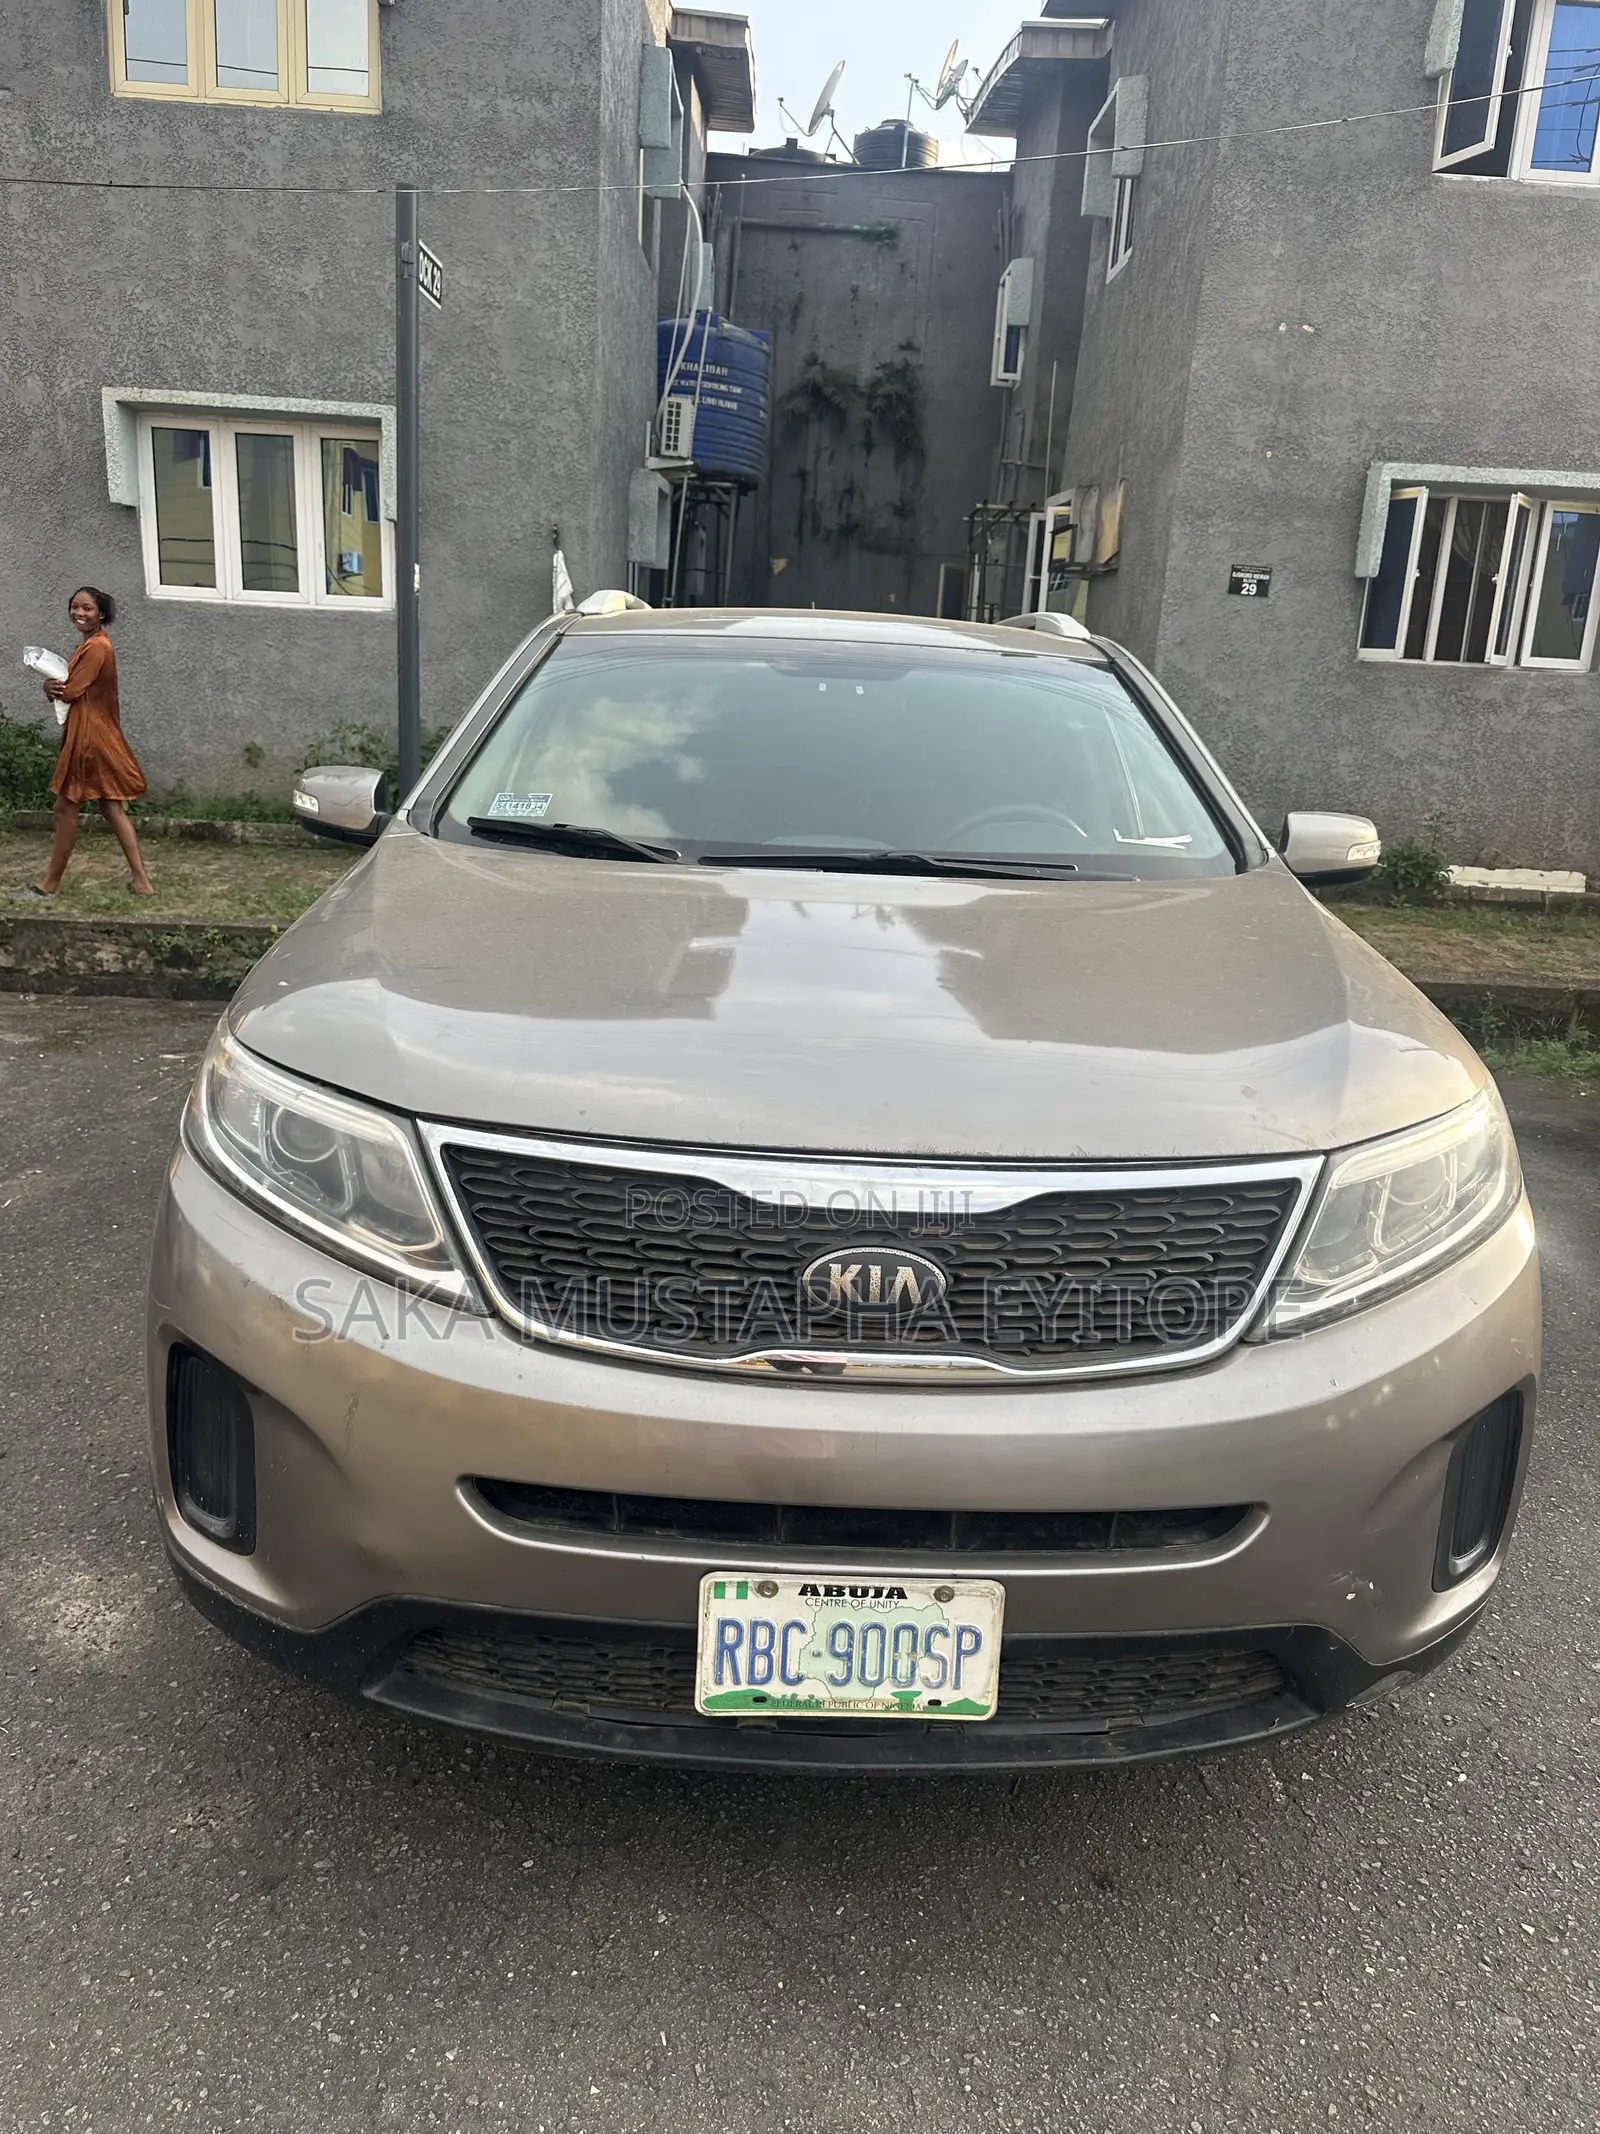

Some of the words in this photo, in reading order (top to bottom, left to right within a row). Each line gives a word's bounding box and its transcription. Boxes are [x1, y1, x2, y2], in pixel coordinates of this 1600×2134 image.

[419, 251, 433, 292] OCK
[433, 266, 441, 300] 29
[1240, 582, 1257, 596] 29
[828, 1263, 922, 1304] KIA
[798, 1583, 908, 1600] ABUJA
[805, 1597, 848, 1609] CENTRE
[850, 1598, 867, 1609] OF
[869, 1598, 901, 1610] UNITY
[714, 1617, 984, 1690] RBC-900SP
[771, 1699, 817, 1709] FEDERAL
[818, 1700, 864, 1710] REPUBLIC
[865, 1701, 880, 1709] OF
